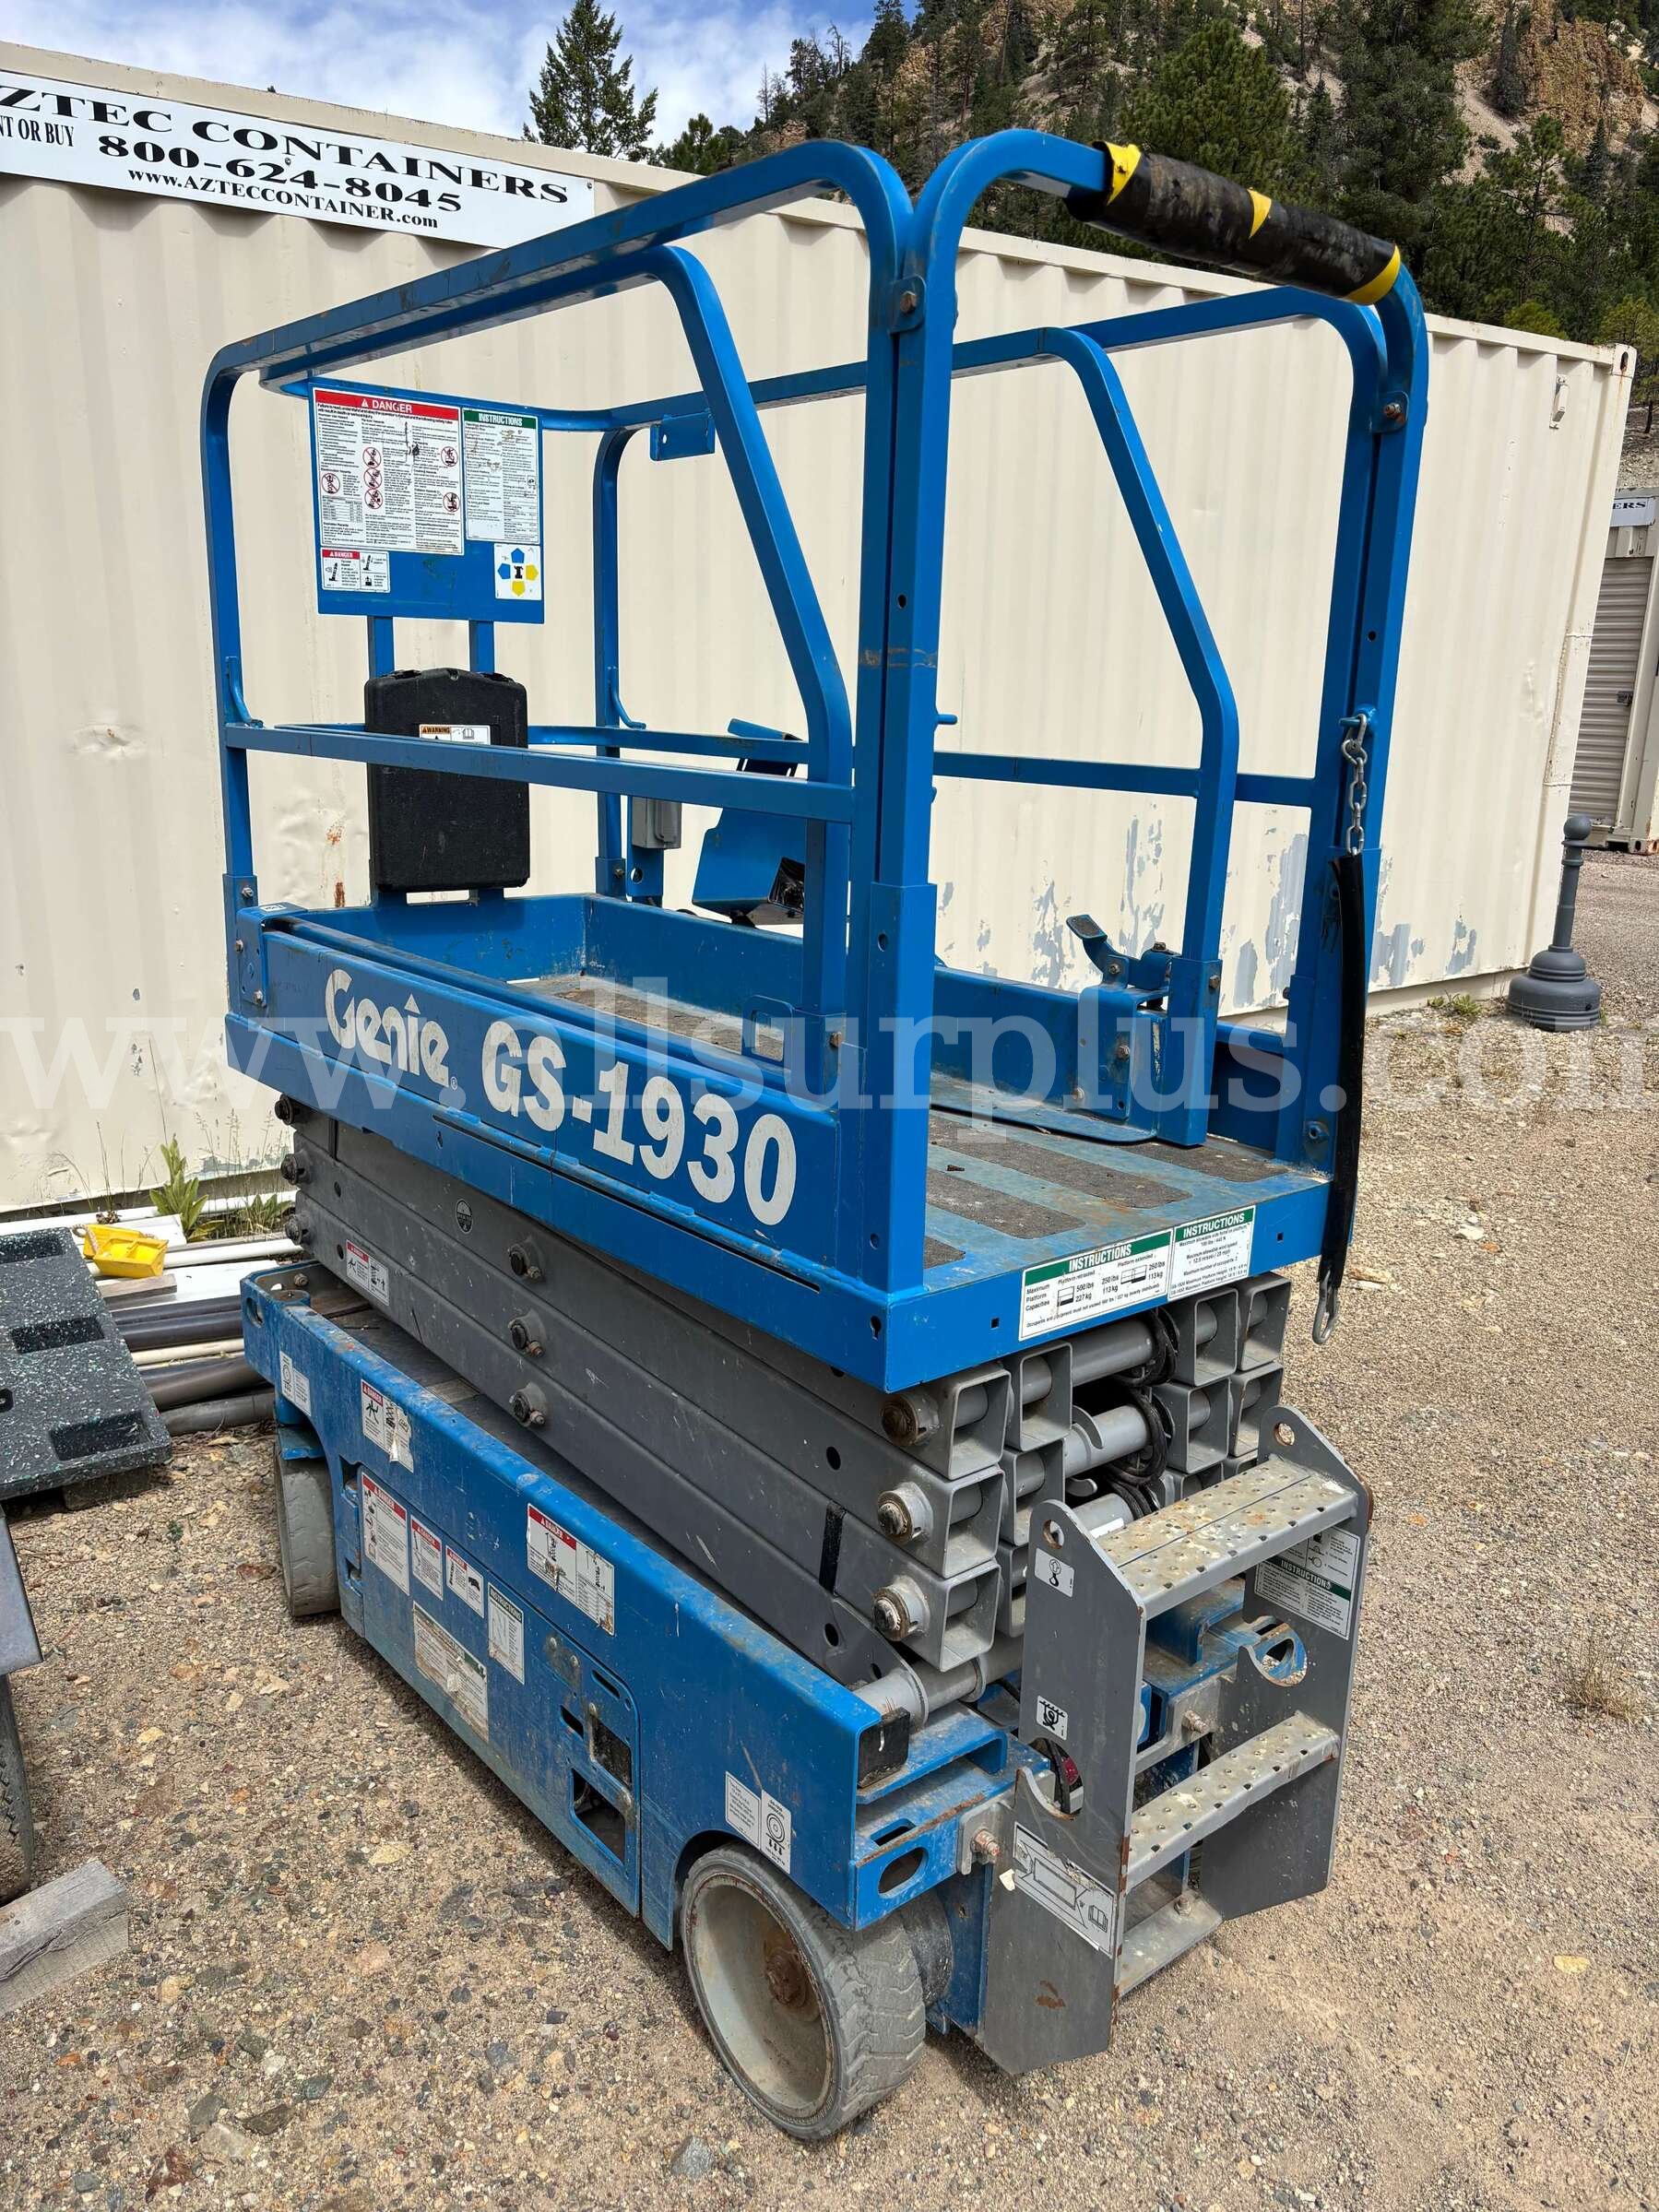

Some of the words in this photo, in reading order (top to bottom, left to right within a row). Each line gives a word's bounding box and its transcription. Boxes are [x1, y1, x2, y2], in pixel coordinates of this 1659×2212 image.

[18, 118, 42, 142] OR
[44, 122, 74, 147] BUY
[98, 136, 462, 212] 800-624-8045
[192, 121, 568, 204] CONTAINERS
[127, 170, 438, 229] www.AZTECCONTAINER.com
[372, 399, 413, 414] DANGER
[479, 413, 523, 427] INSTRUCTIONS
[325, 968, 450, 1088] Genie
[482, 1020, 797, 1226] GS-1930
[1183, 1212, 1245, 1238] INSTRUCTIONS
[1069, 1244, 1132, 1272] INSTRUCTIONS
[1281, 1559, 1333, 1590] INSTRUCTIONS
